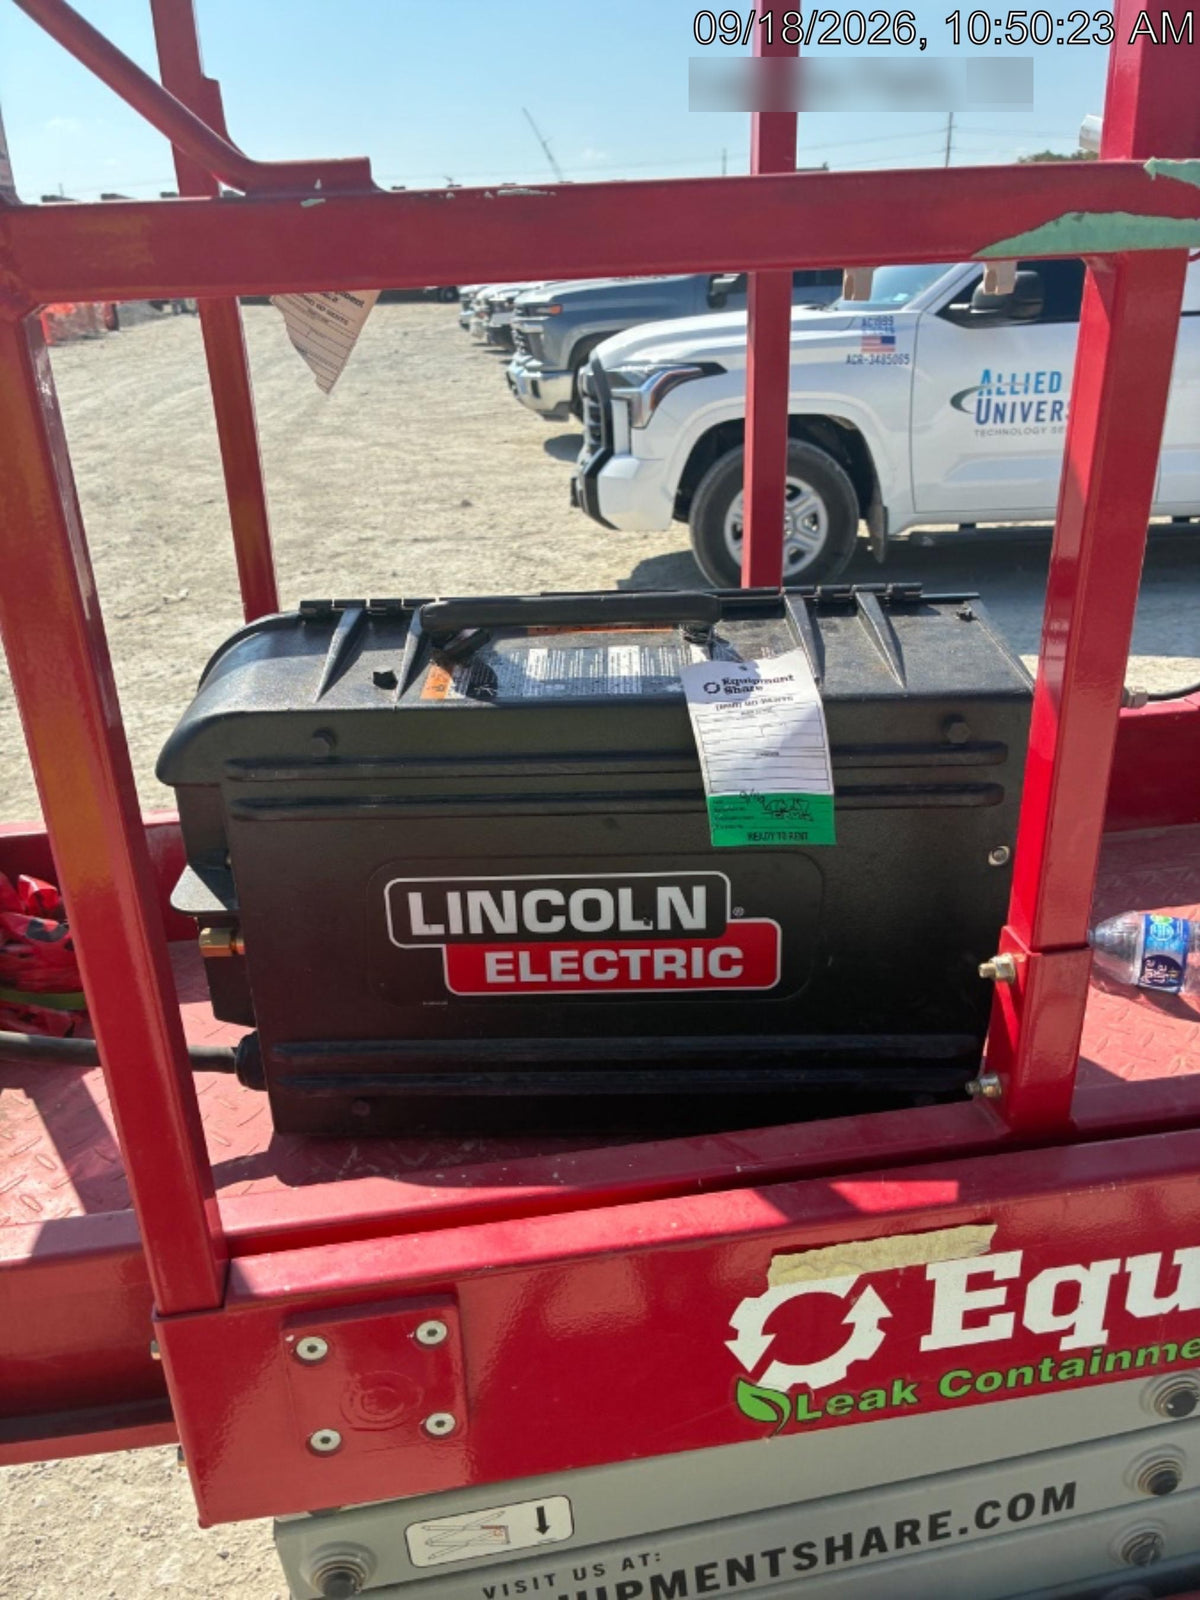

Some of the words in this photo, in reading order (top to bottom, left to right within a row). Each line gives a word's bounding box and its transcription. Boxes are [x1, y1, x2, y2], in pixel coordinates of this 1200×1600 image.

[977, 369, 1062, 396] ALLIED
[973, 426, 1048, 437] TECHNOLOGY
[722, 674, 794, 686] Equipment
[723, 685, 763, 695] Share
[747, 831, 775, 841] READY
[408, 885, 706, 936] LINCOLN
[484, 946, 744, 984] ELECTRIC
[919, 1246, 1200, 1352] Equ
[796, 1378, 918, 1422] Leak
[938, 1336, 1200, 1398] Containme
[483, 1572, 556, 1600] VISIT
[573, 1563, 606, 1581] US
[621, 1552, 661, 1571] AT:
